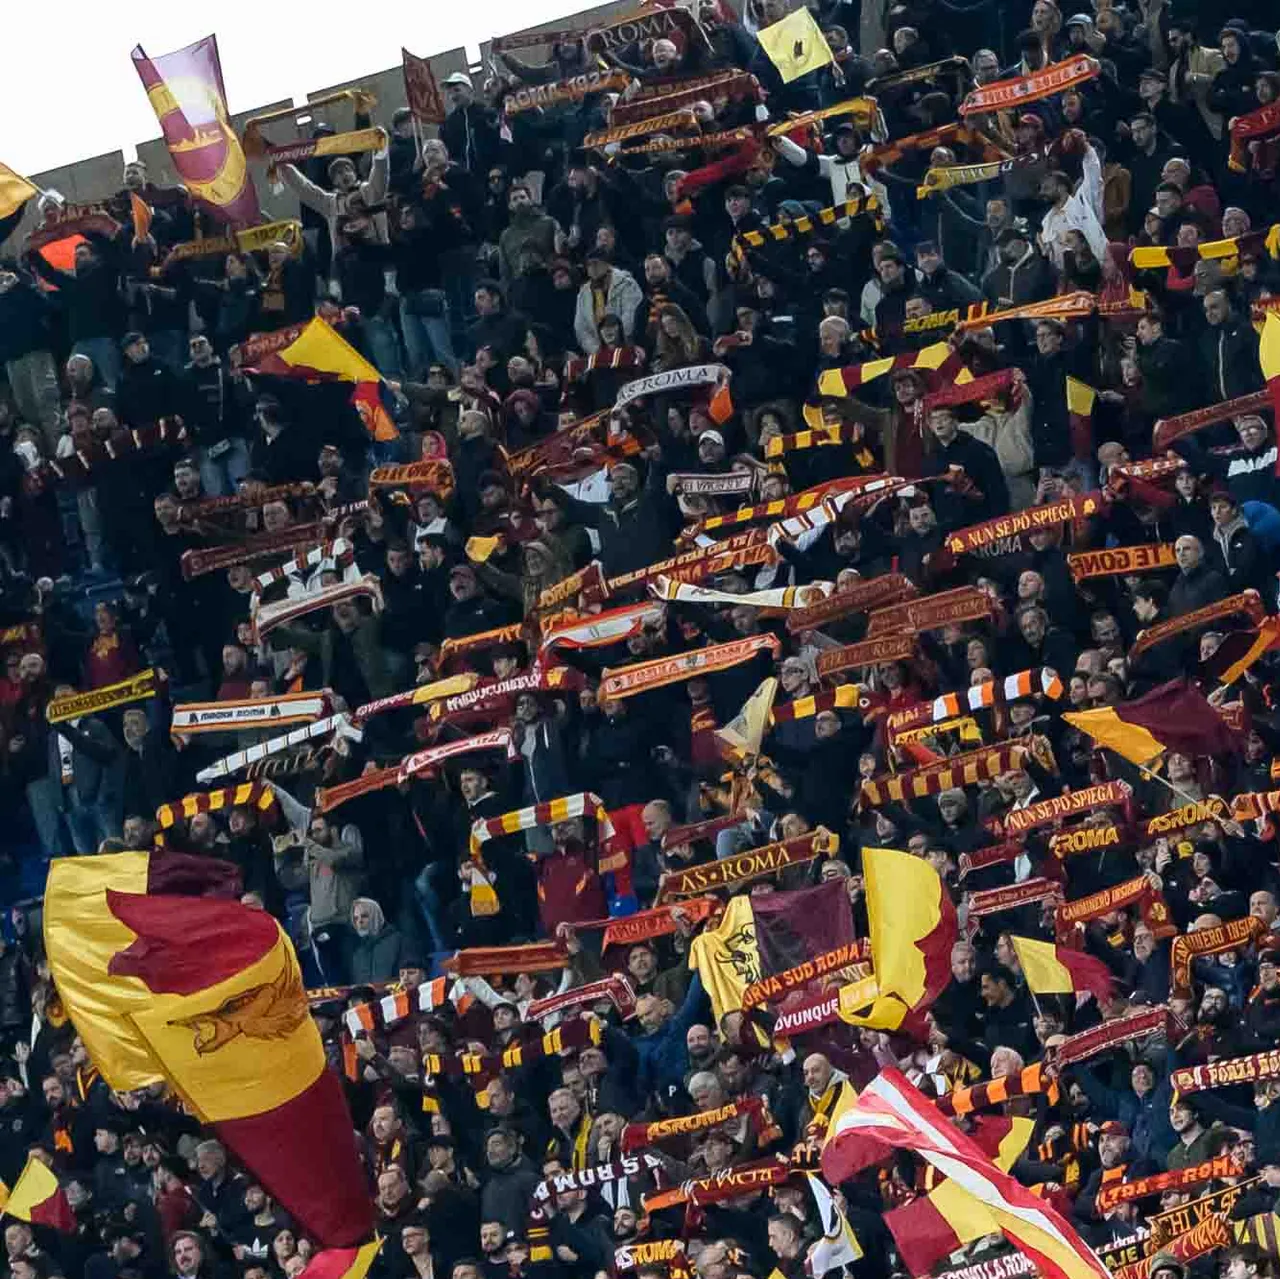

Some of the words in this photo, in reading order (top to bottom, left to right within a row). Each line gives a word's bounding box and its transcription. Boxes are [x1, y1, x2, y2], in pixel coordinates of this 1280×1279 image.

[600, 12, 678, 50] ROMA
[649, 365, 709, 396] ROMA
[969, 519, 1002, 553] NUN
[1004, 514, 1021, 543] SE
[1035, 500, 1077, 534] SPIEGA
[1010, 801, 1039, 831] NUN
[1040, 798, 1057, 823] SE
[1070, 785, 1115, 816] SPIEGA
[1062, 825, 1118, 857] ROMA
[782, 957, 814, 994] SUD
[818, 940, 860, 981] ROMA
[1182, 1153, 1244, 1194] ROMA
